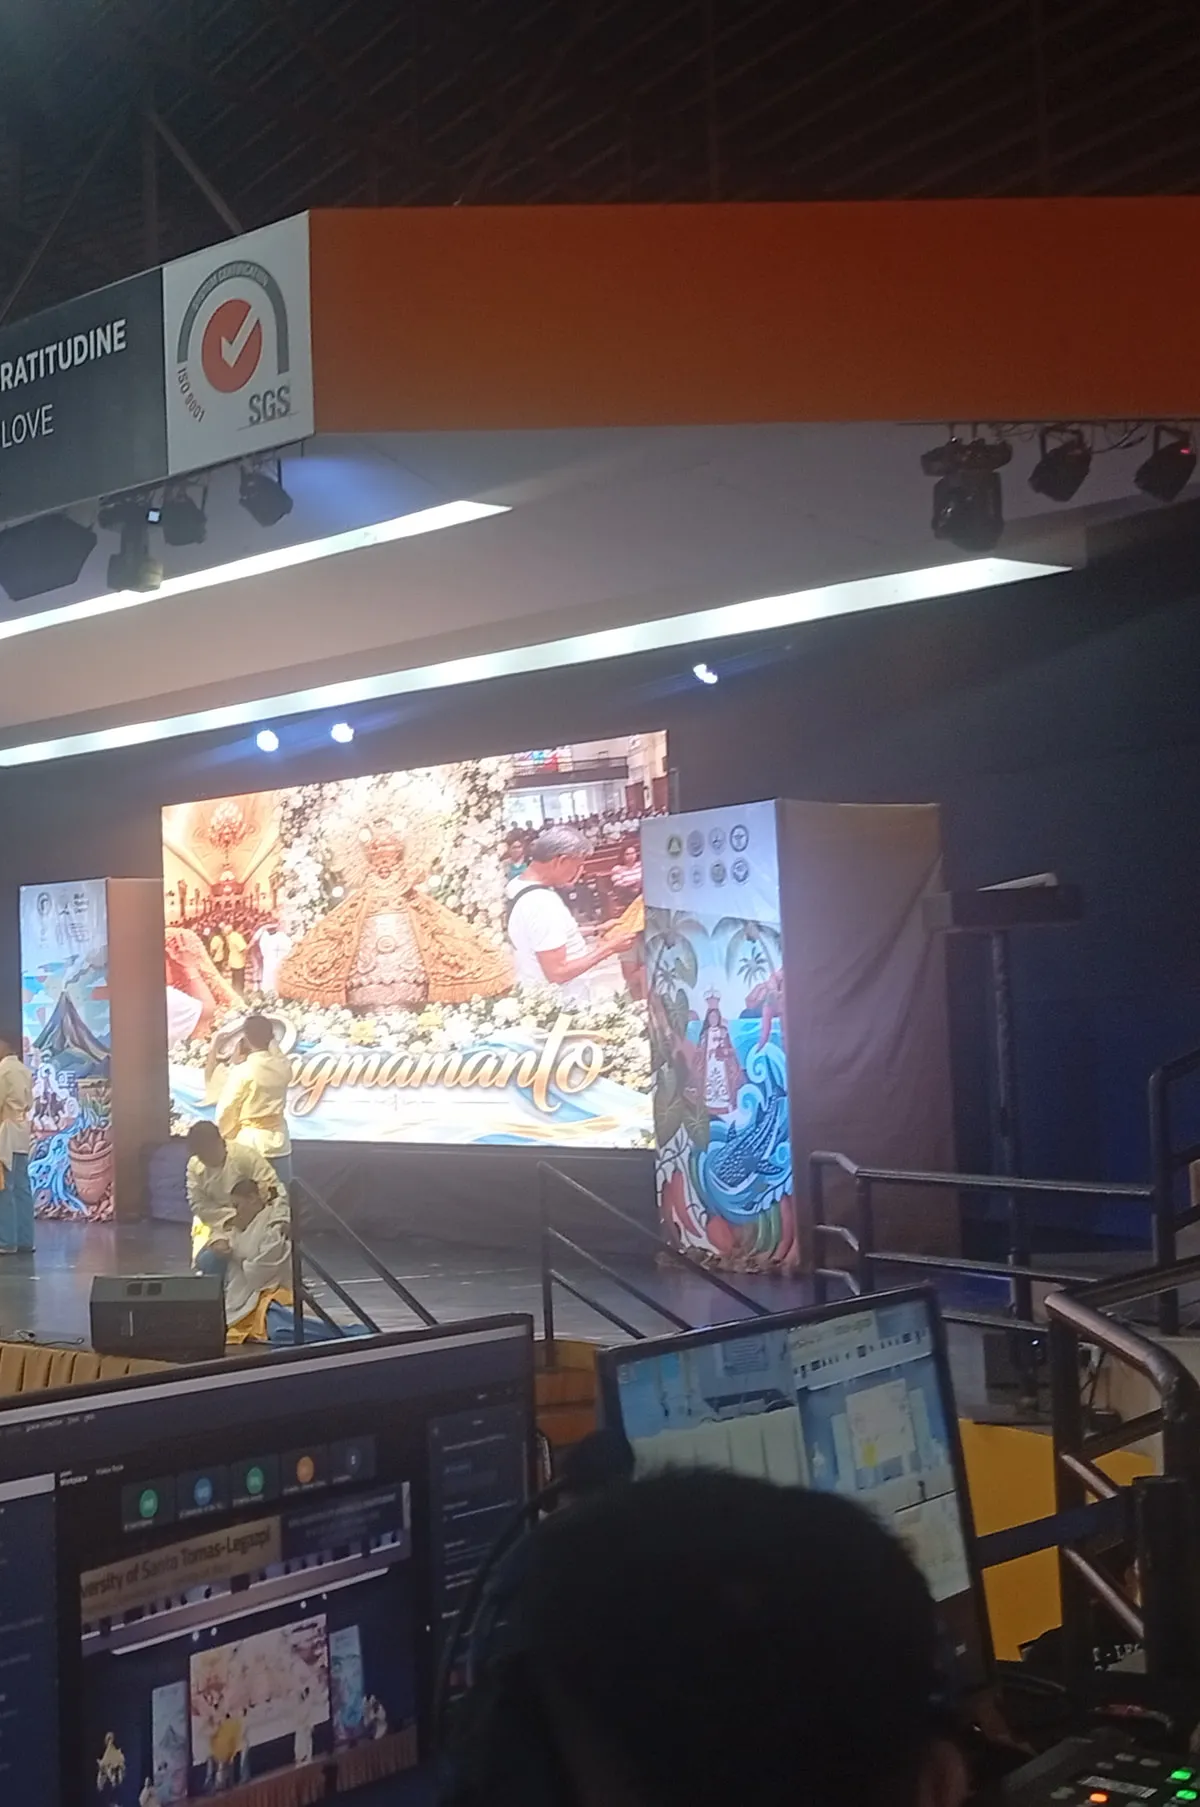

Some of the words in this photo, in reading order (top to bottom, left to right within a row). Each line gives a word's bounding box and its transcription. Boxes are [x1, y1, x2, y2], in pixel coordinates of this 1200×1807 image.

[177, 367, 190, 394] ISO
[1, 404, 54, 448] LOVE
[248, 385, 291, 426] SGS
